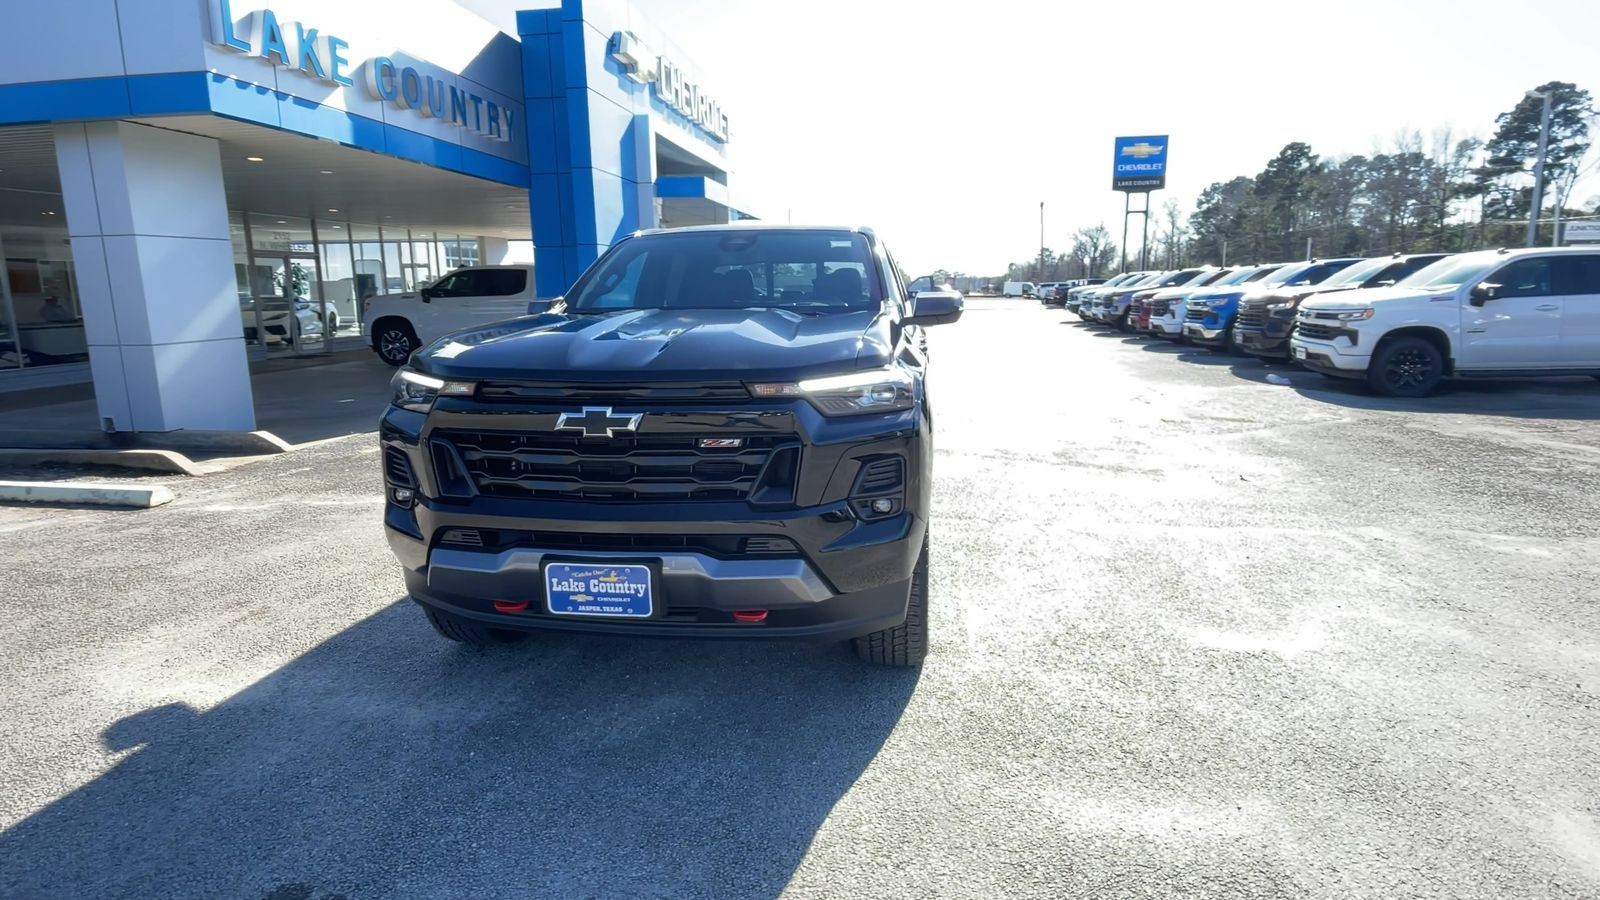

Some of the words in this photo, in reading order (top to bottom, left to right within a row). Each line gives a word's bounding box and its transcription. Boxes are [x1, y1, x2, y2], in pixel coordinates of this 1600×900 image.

[216, 0, 353, 87] LAKE
[372, 56, 513, 141] COUNTRY
[1118, 163, 1162, 171] CHEVROLET
[552, 578, 585, 592] Lake
[590, 579, 646, 597] Country
